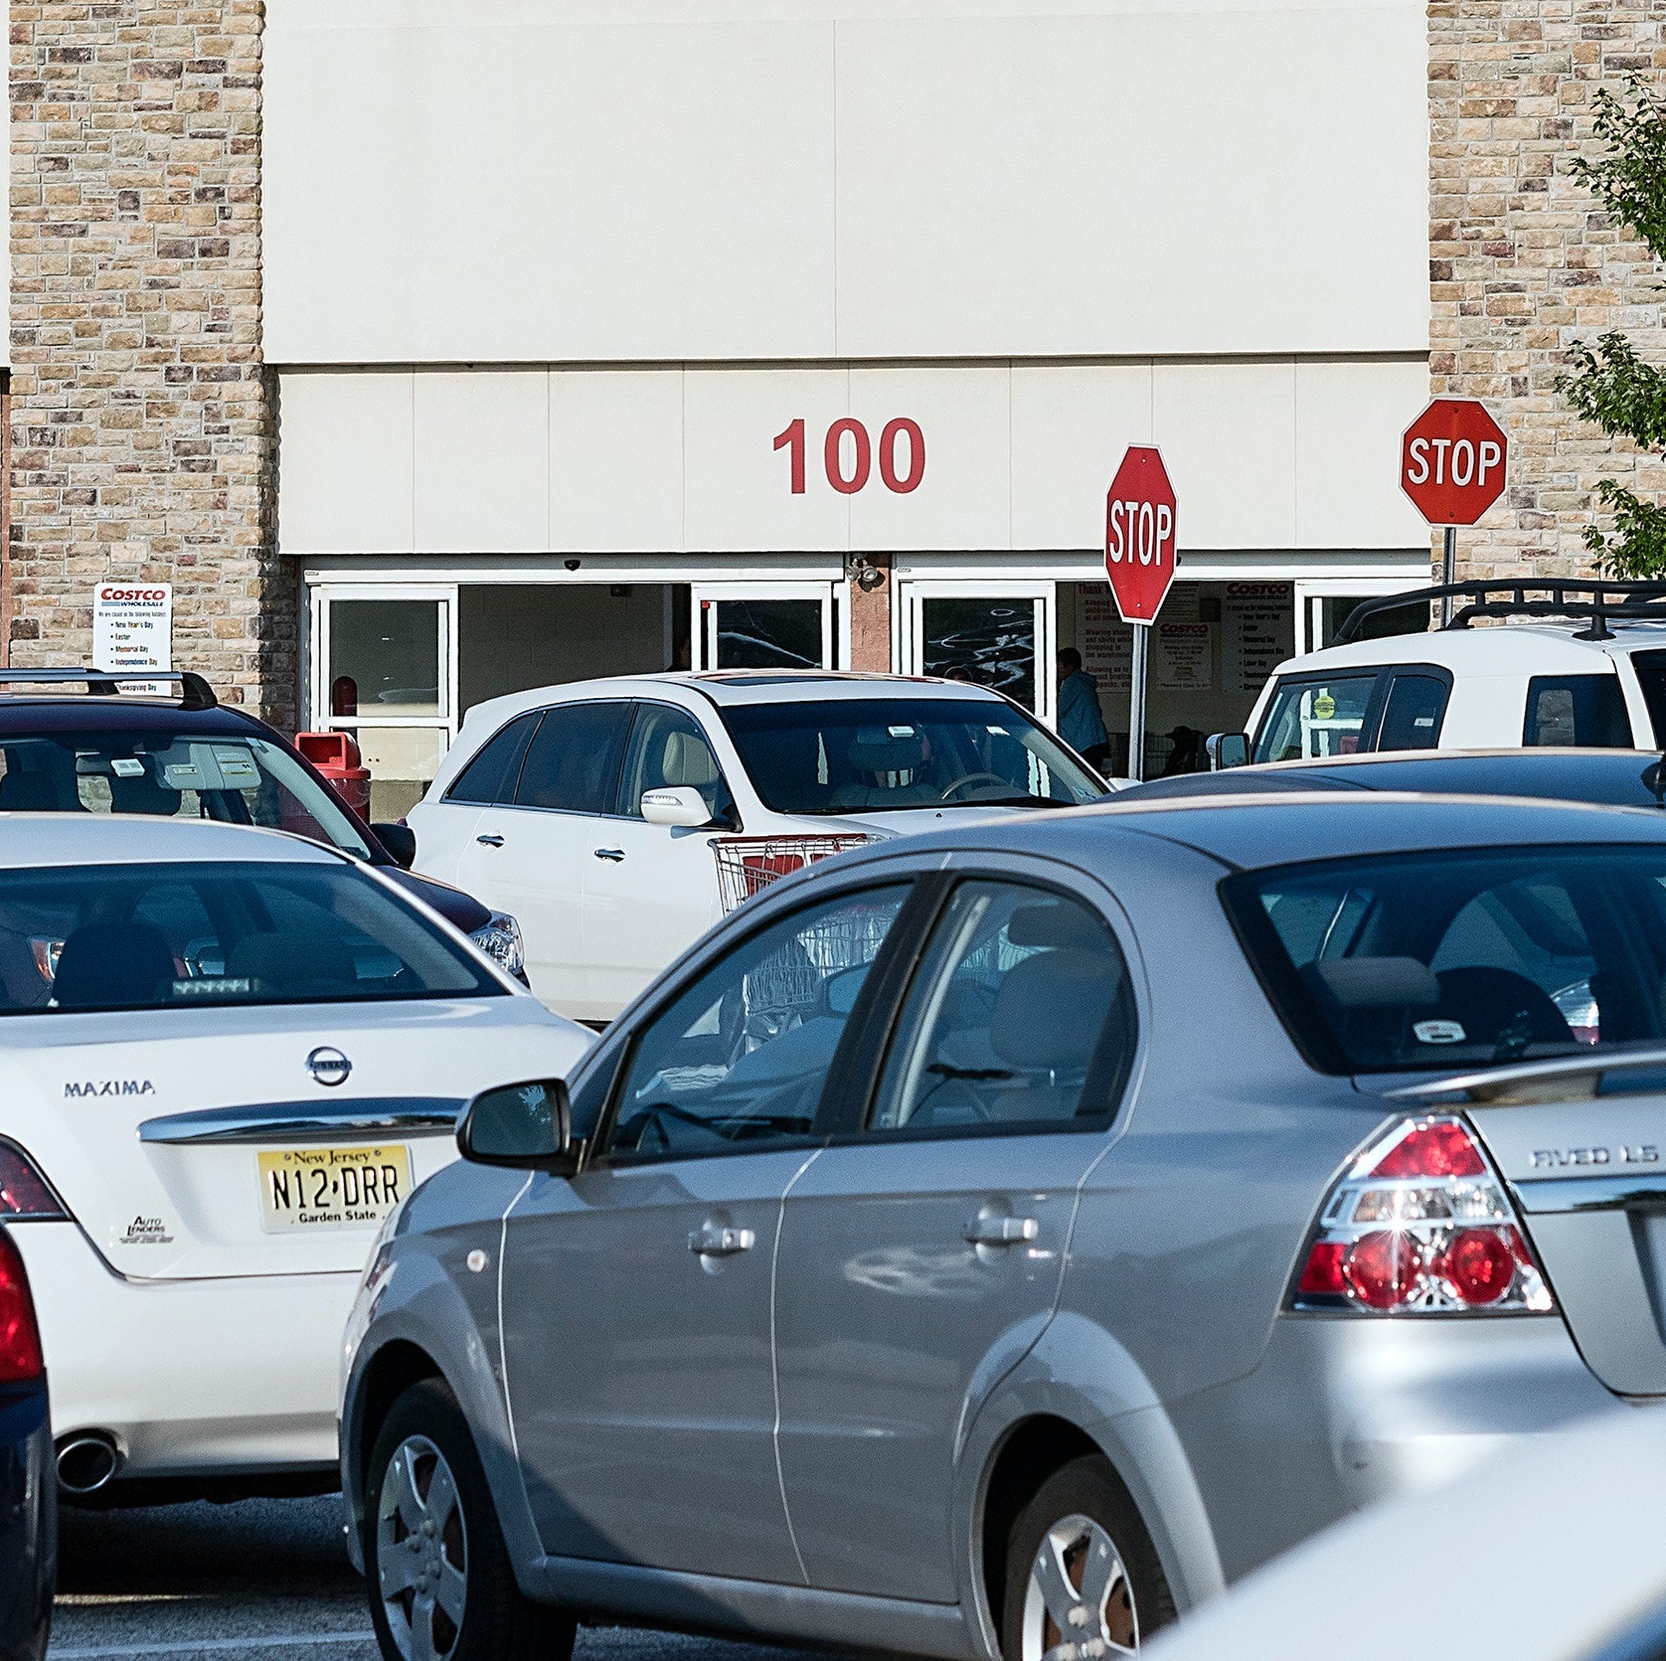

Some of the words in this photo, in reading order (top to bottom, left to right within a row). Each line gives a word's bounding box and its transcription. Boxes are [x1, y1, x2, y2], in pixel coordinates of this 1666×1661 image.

[773, 418, 925, 495] 100
[1407, 437, 1501, 486] STOP
[1109, 499, 1172, 566] STOP
[100, 587, 166, 601] COSTCO
[1226, 583, 1290, 595] COSTCO
[1159, 622, 1209, 634] COSTCO
[64, 1080, 156, 1098] MAXIMA
[294, 1152, 325, 1165] New
[329, 1150, 371, 1166] Jersey
[1530, 1147, 1610, 1168] AVEO
[299, 1213, 341, 1224] Garden
[345, 1211, 376, 1221] State
